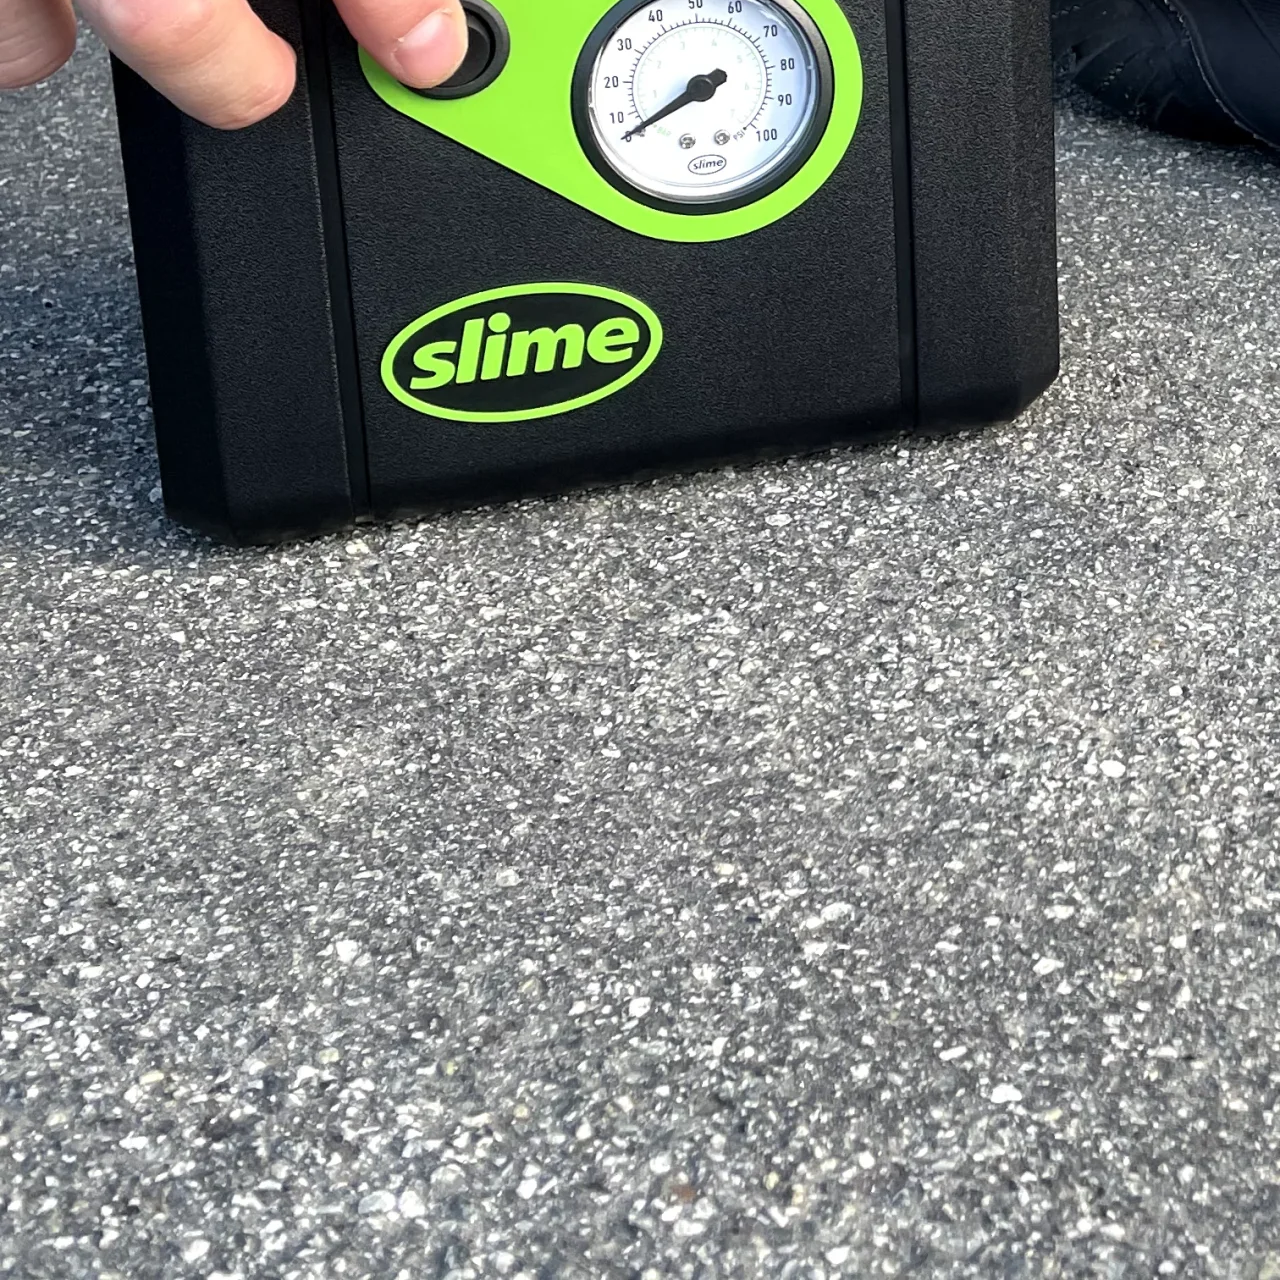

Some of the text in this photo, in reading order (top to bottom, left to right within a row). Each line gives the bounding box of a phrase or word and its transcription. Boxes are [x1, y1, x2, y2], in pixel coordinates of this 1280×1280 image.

[727, 0, 743, 14] 60
[648, 9, 664, 23] 40
[763, 24, 778, 38] 70
[617, 38, 632, 51] 30
[780, 58, 795, 71] 80
[604, 76, 619, 88] 20
[777, 94, 793, 107] 90
[609, 111, 624, 124] 10
[733, 130, 746, 142] PSI
[756, 128, 778, 142] 100
[693, 158, 724, 170] slime
[409, 312, 641, 391] slime
